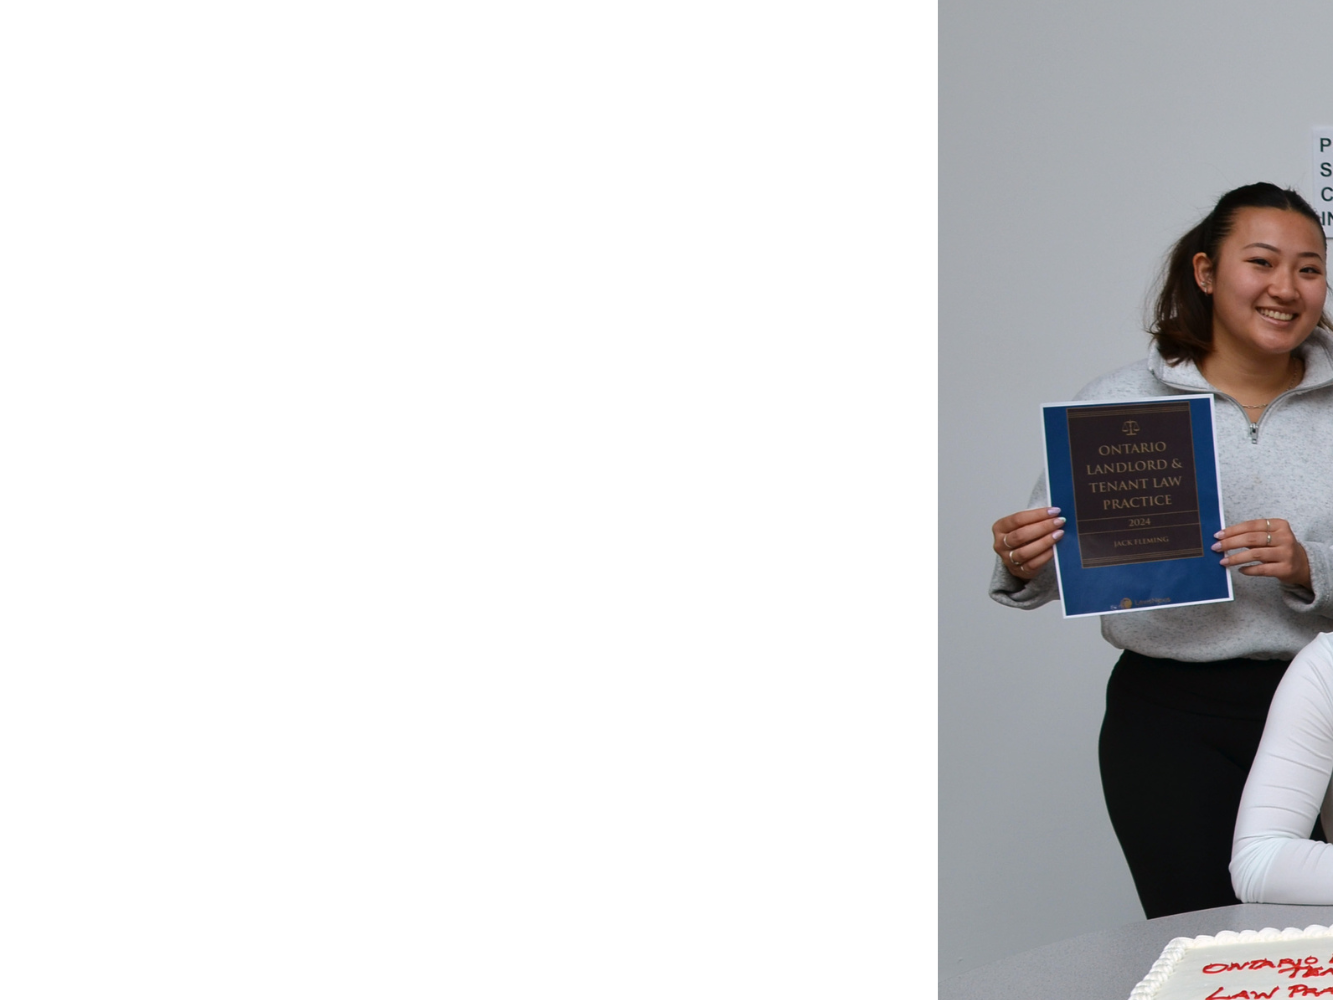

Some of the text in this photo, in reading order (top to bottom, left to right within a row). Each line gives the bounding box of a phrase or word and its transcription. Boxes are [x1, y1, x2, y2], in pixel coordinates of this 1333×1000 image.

[1098, 441, 1167, 456] ONTARIO
[1086, 458, 1183, 475] LANDLORD &
[1088, 476, 1183, 493] TENANT LAW
[1103, 494, 1173, 510] PRACTICE
[1128, 517, 1151, 527] 2024
[1113, 536, 1170, 548] JACK FLEMING
[1202, 955, 1319, 975] ONTARIO
[1205, 986, 1281, 1000] LAW
